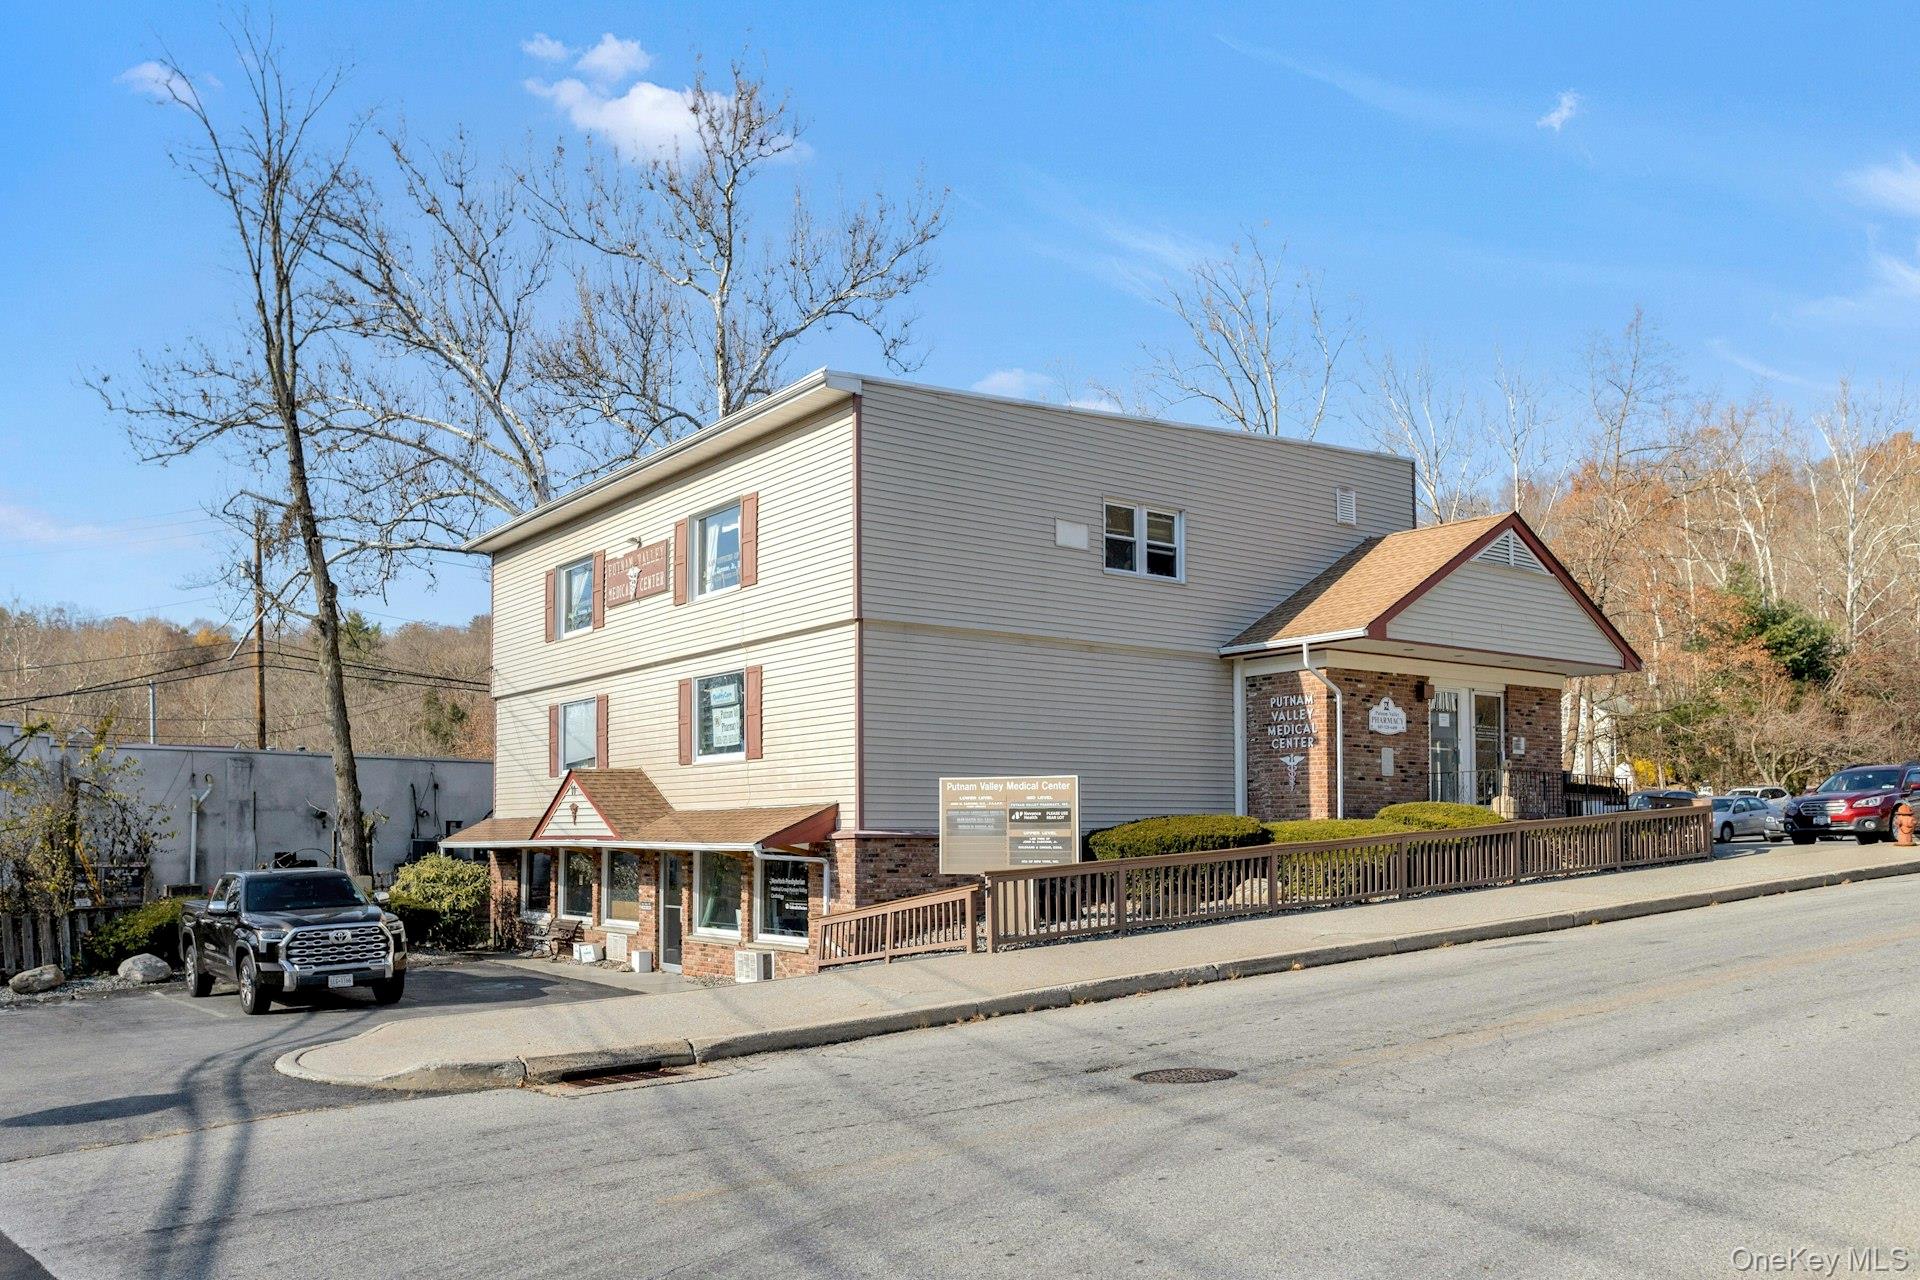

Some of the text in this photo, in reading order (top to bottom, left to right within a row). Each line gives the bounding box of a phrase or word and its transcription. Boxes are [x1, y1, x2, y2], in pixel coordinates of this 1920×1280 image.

[639, 572, 665, 592] CENTER
[1270, 694, 1314, 708] PUTNAM
[1271, 707, 1314, 721] VALLEY
[1371, 716, 1403, 725] PHARMACY
[1267, 722, 1318, 736] MEDICAL
[1271, 736, 1315, 749] CENTER
[946, 781, 1070, 792] Putnam Valley Medical Center
